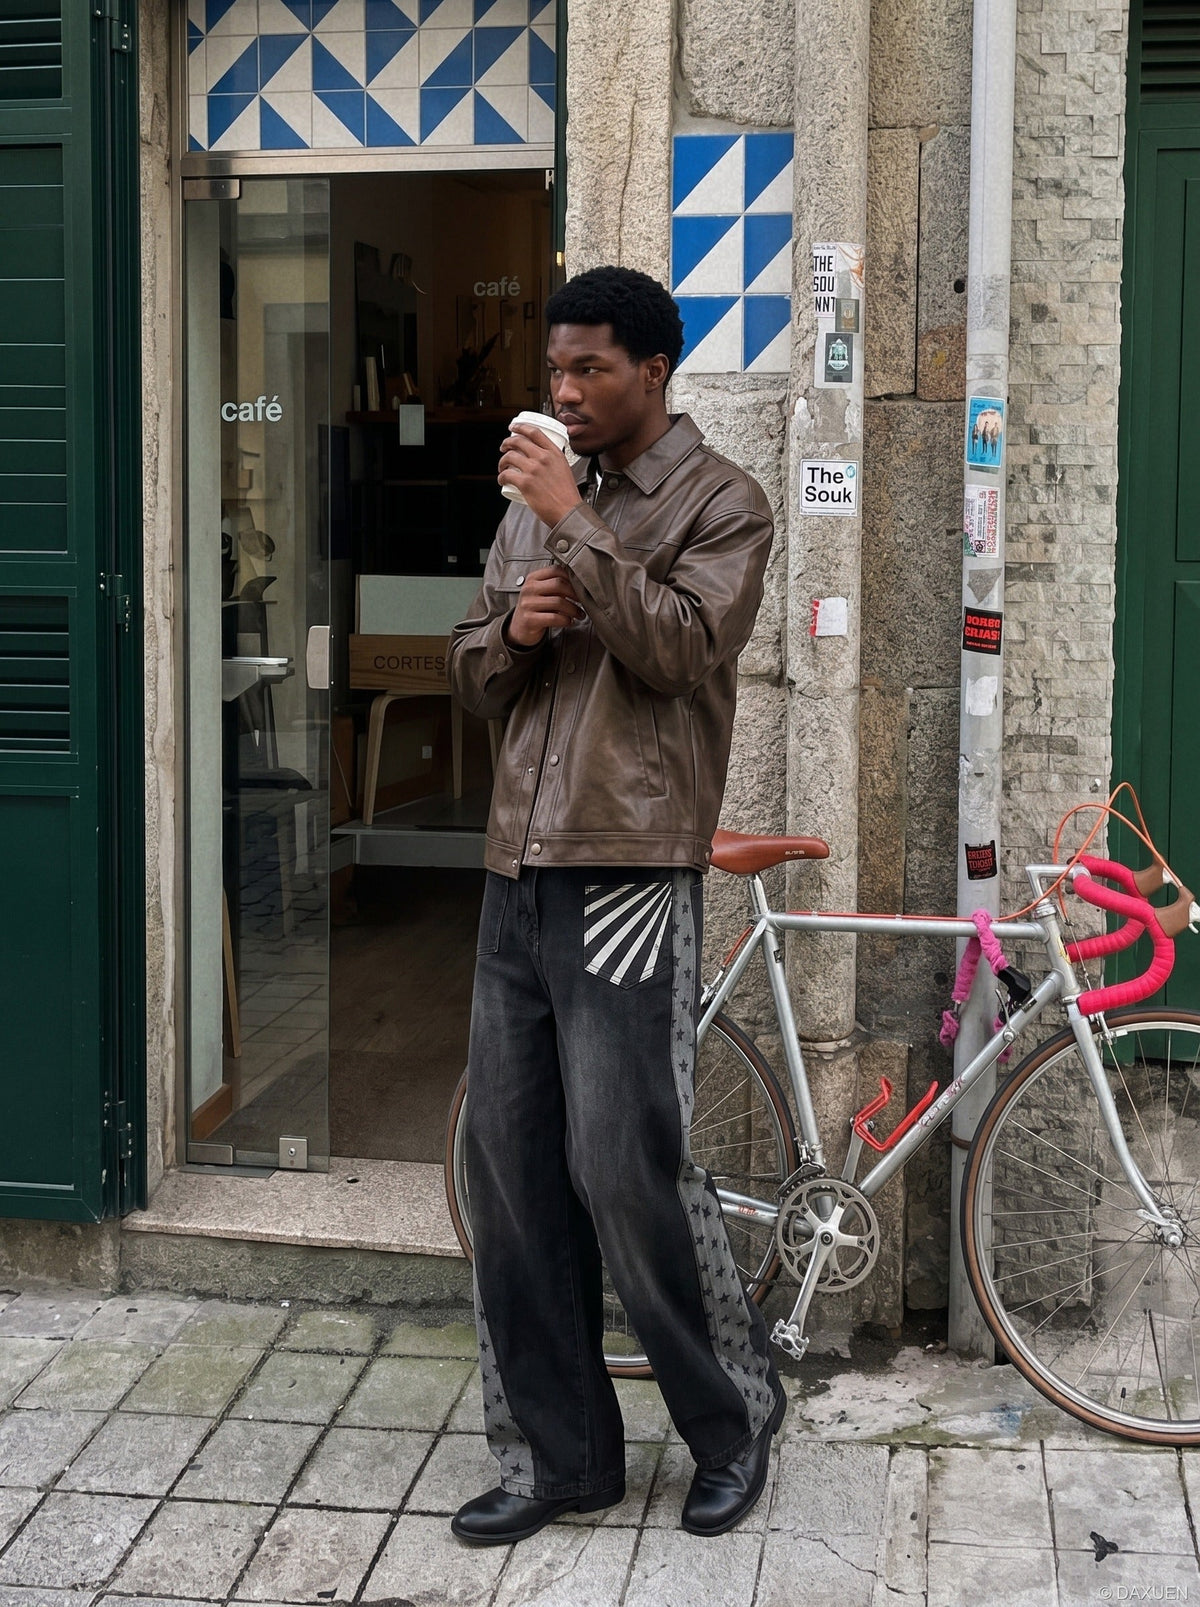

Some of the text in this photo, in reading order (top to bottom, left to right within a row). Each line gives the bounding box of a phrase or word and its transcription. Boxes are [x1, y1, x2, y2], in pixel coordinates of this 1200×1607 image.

[813, 255, 834, 272] THE
[473, 276, 521, 297] café
[813, 276, 835, 292] SOU
[221, 395, 283, 422] café
[807, 467, 844, 484] The
[805, 486, 852, 503] Souk
[373, 656, 446, 671] CORTES
